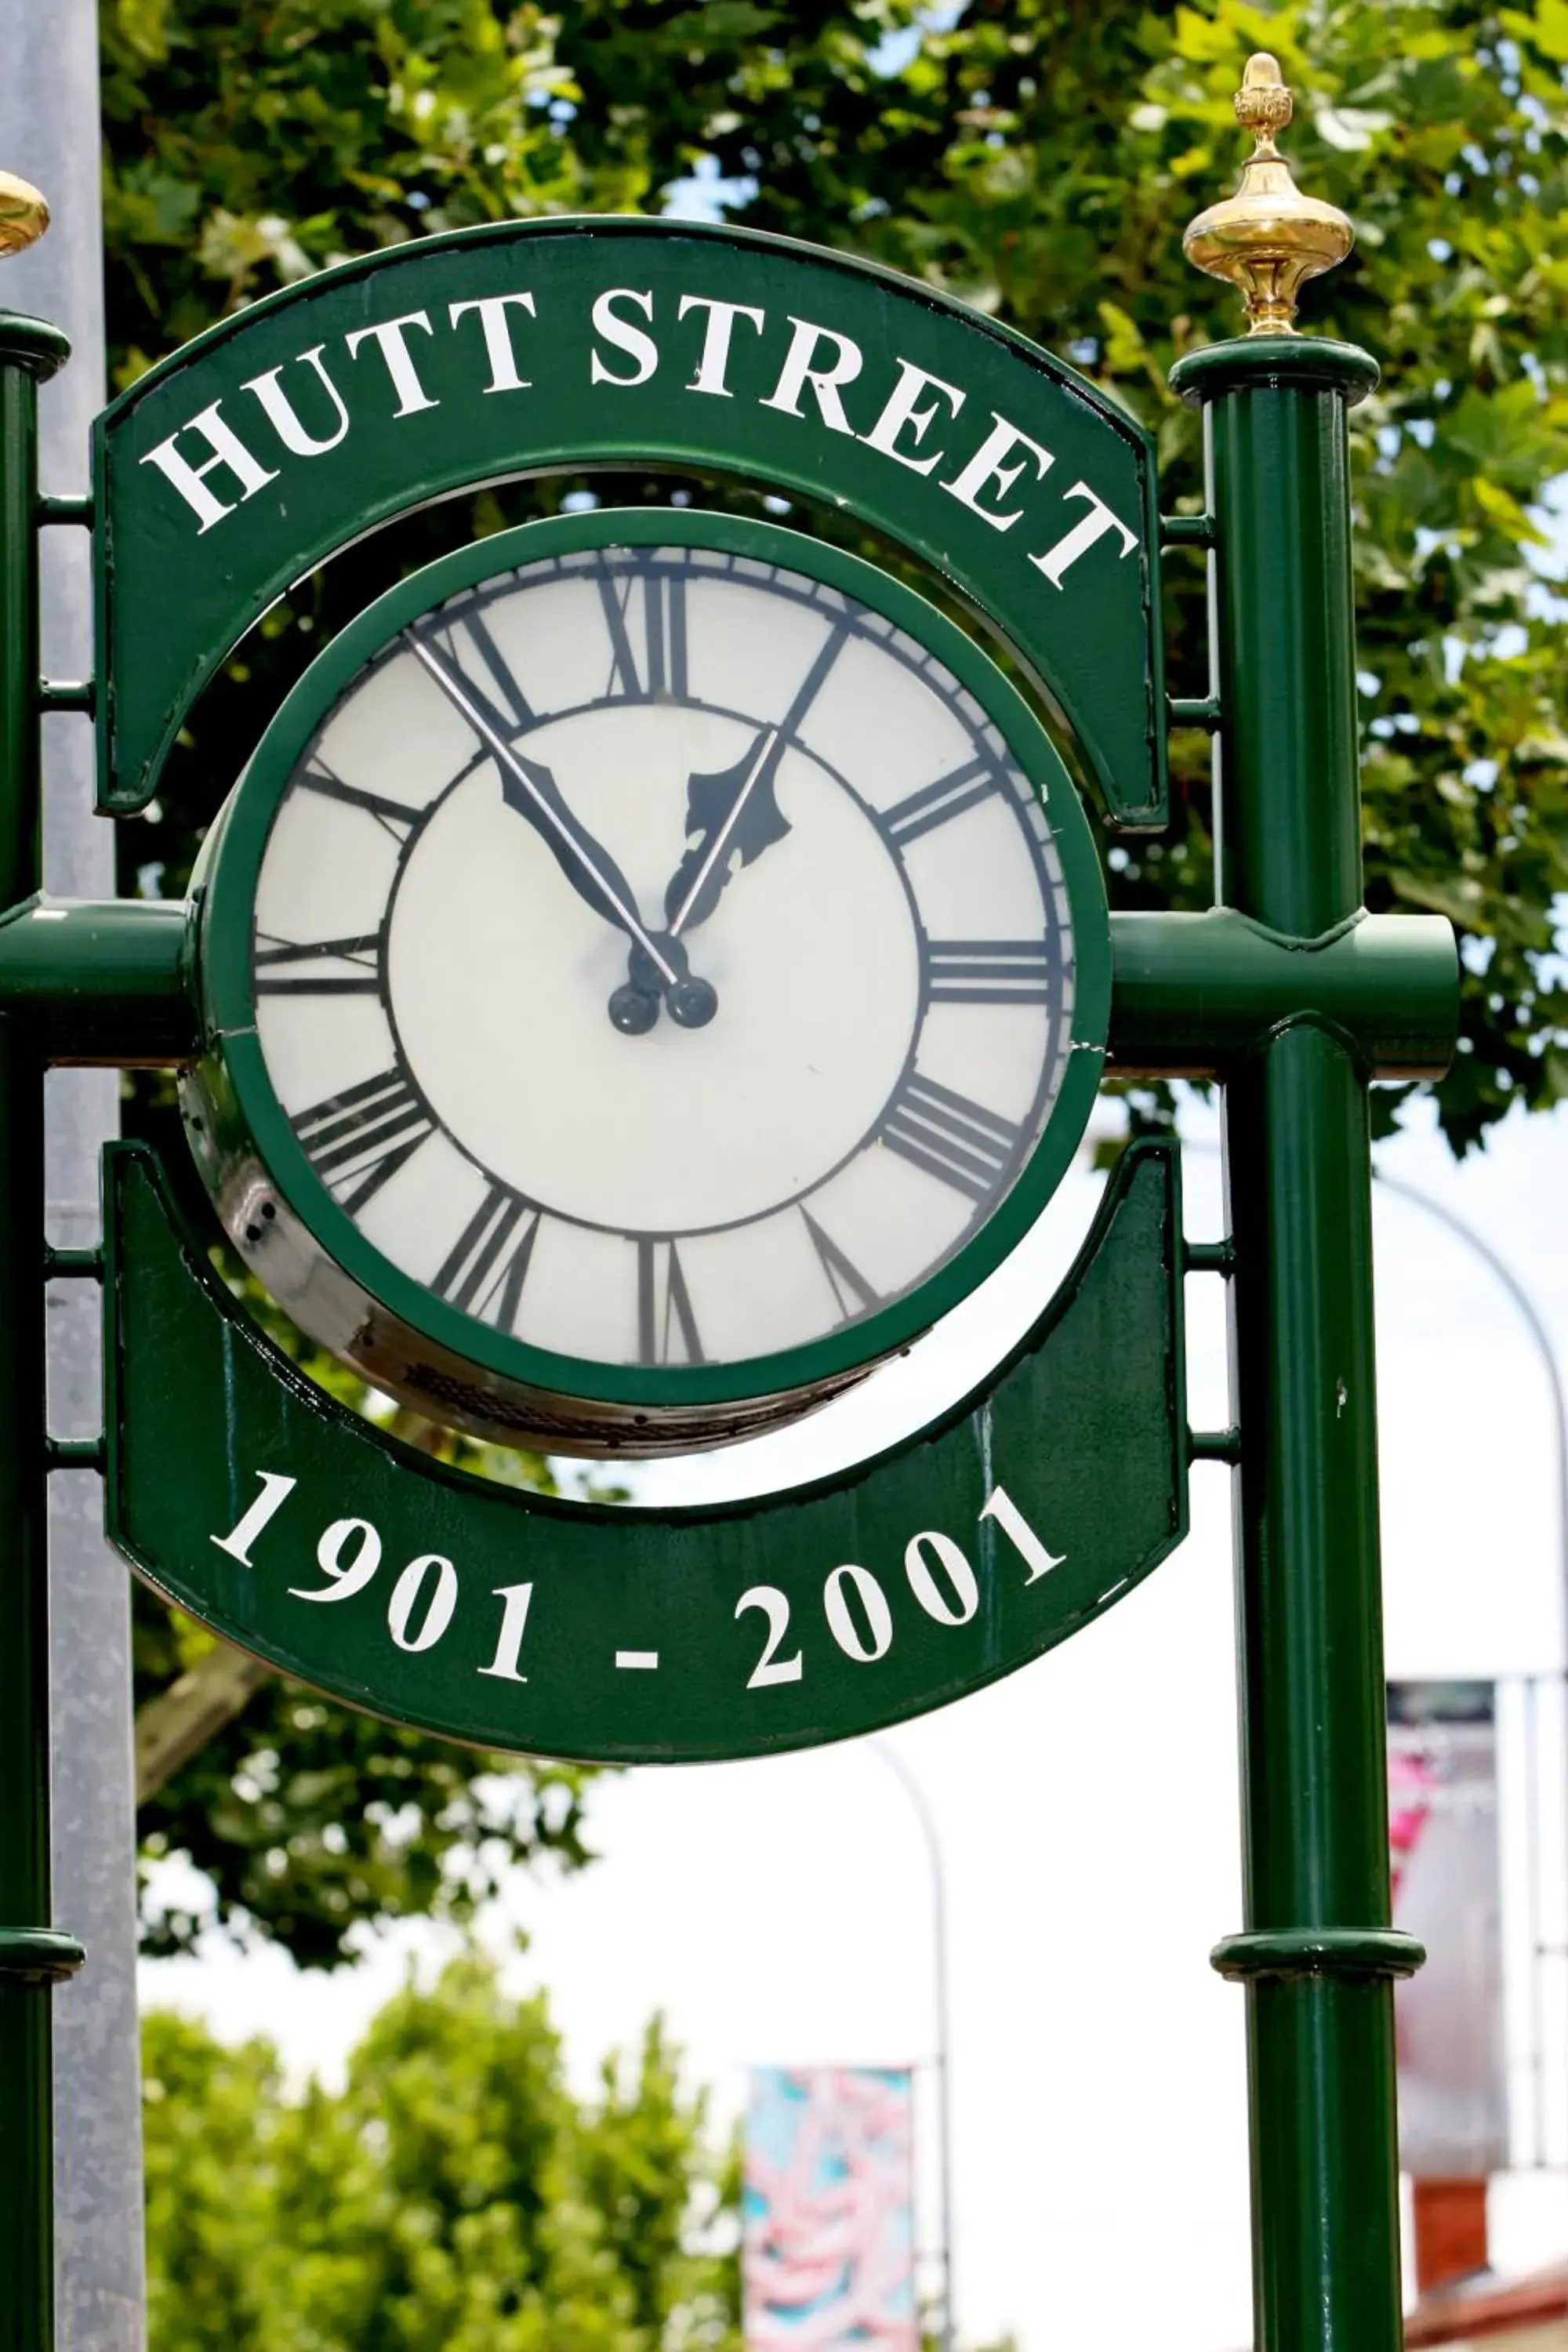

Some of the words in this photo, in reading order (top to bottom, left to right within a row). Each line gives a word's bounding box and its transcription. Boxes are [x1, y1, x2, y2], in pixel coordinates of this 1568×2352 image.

[140, 292, 536, 535] HUTT
[592, 289, 1139, 590] STREET
[920, 925, 1054, 1019] III
[211, 1470, 533, 1682] 1901
[735, 1486, 1066, 1689] 2001
